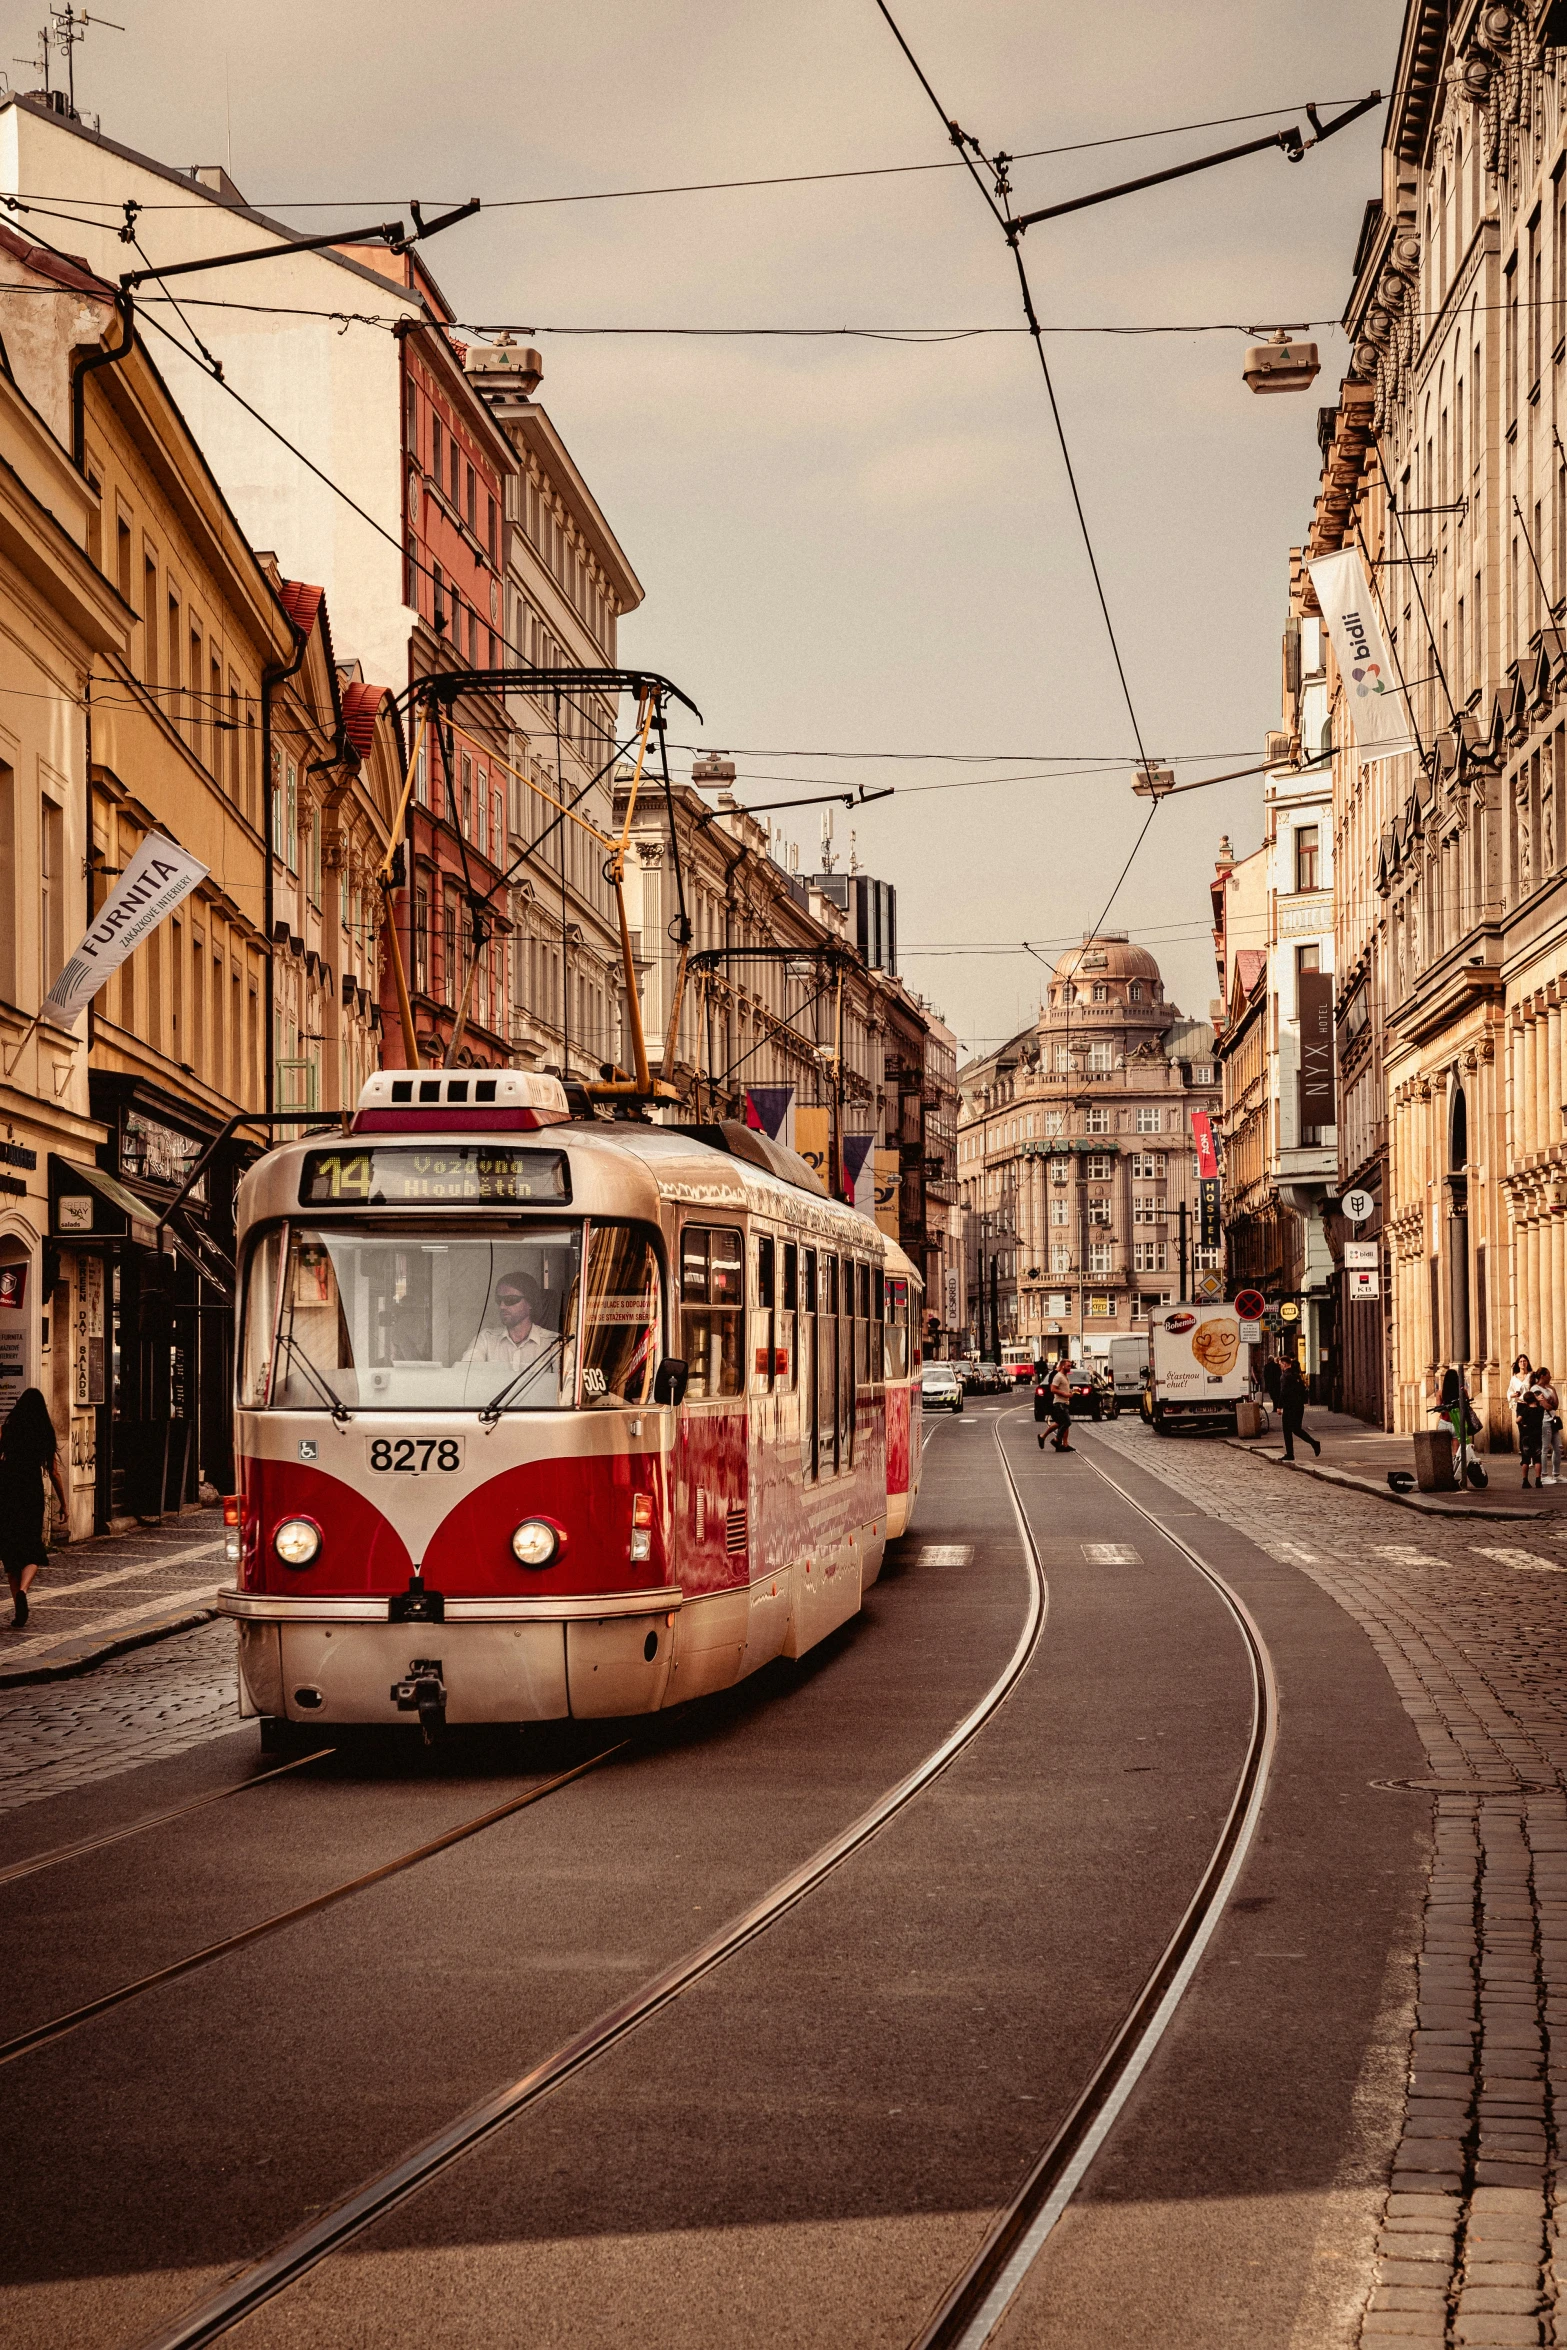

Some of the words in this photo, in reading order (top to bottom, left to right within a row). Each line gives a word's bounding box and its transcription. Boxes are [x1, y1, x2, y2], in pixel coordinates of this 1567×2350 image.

[1341, 611, 1371, 661] bidli
[81, 859, 179, 958] FURNITA
[119, 905, 160, 948] ZAKÁZKOVÉ
[156, 874, 193, 910] INTERIERY
[1318, 1003, 1328, 1033] HOTEL
[1304, 1044, 1330, 1096] NYX
[1199, 1133, 1211, 1155] AON
[318, 1154, 371, 1198] 14
[413, 1156, 524, 1174] Vozovna
[403, 1177, 532, 1197] Hloubětín
[60, 1201, 91, 1209] GREEN
[70, 1207, 89, 1215] DAY
[1205, 1182, 1215, 1245] HOSTEL
[78, 1259, 87, 1303] GREEN
[621, 1300, 625, 1308] S
[948, 1277, 957, 1319] DESIRRED
[78, 1311, 87, 1336] DAY
[605, 1311, 634, 1321] STAŽENÝM
[1165, 1318, 1196, 1331] Bohemia
[1, 1333, 23, 1341] FURNITA
[78, 1346, 87, 1398] SALADS
[582, 1367, 607, 1391] 503
[1166, 1371, 1200, 1380] Šťastnou
[1166, 1380, 1188, 1388] chuť!
[370, 1438, 460, 1472] 8278
